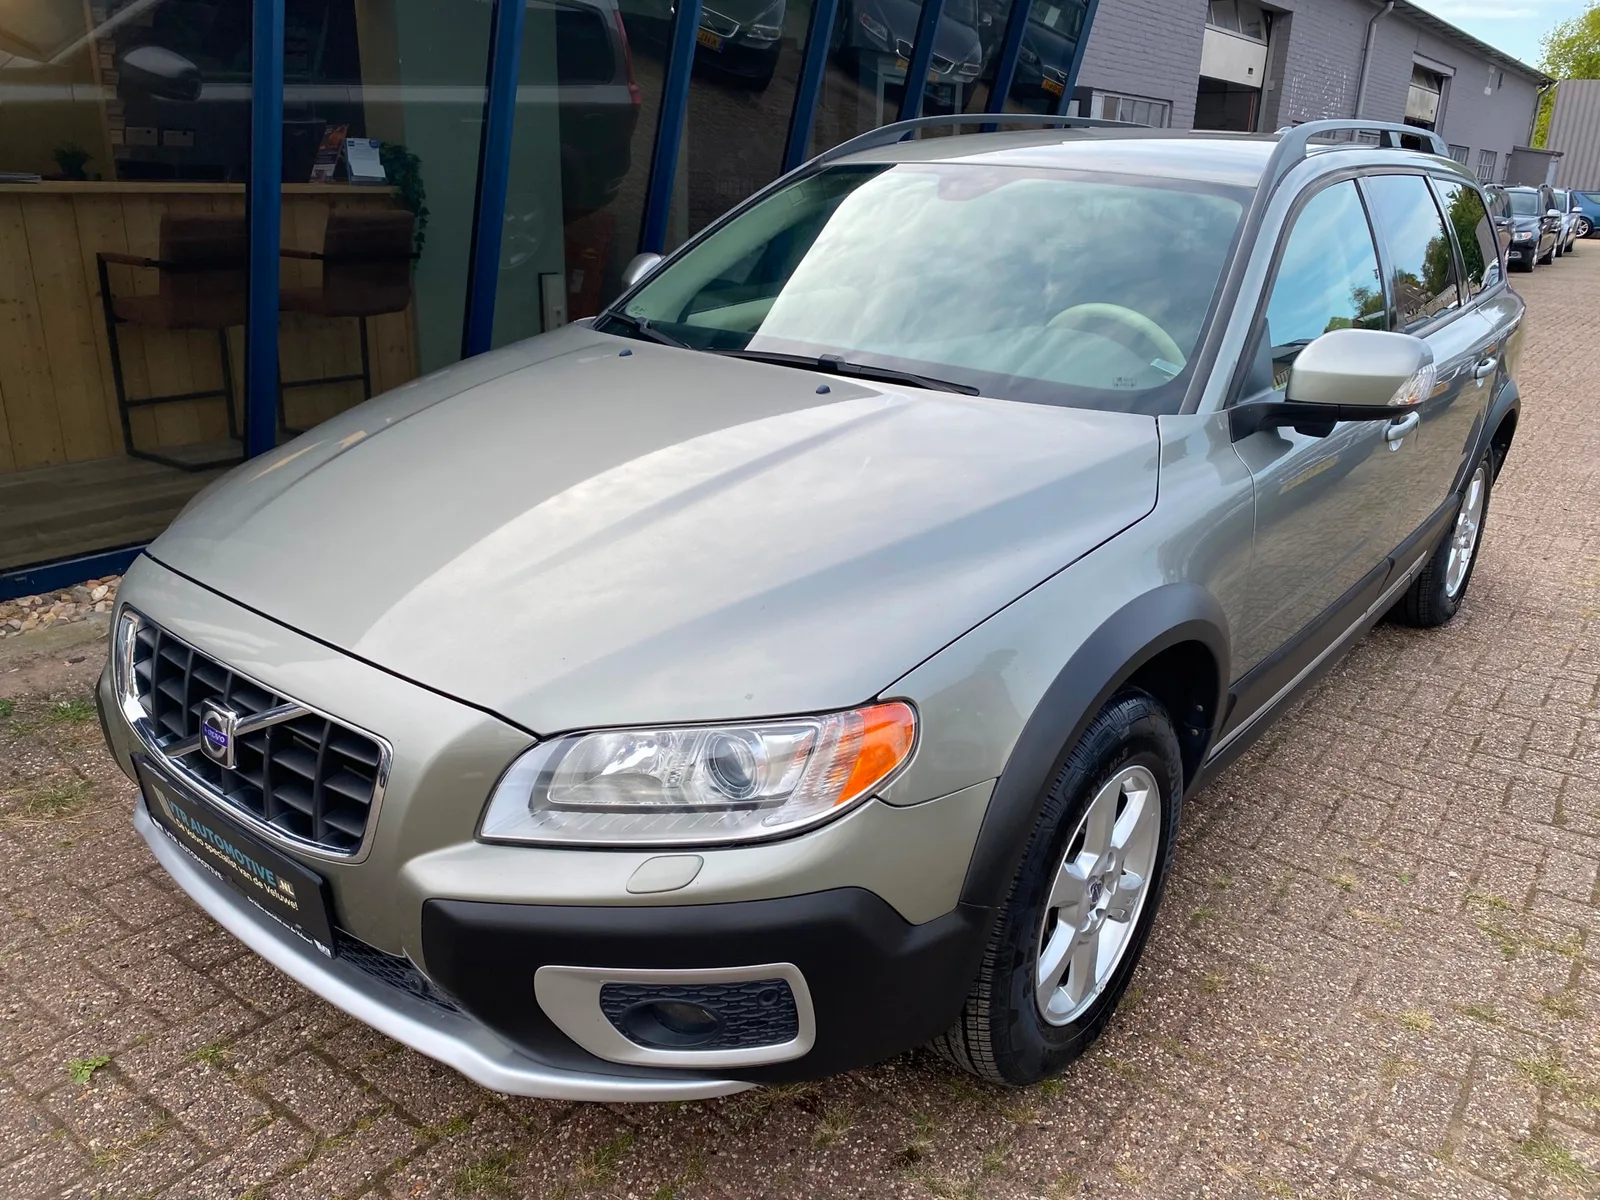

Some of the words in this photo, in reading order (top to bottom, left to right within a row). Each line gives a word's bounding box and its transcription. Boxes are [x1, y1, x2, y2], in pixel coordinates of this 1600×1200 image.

[204, 725, 226, 743] VOLVO
[167, 797, 190, 826] VTR
[191, 817, 277, 888] AUTOMOTIVE
[185, 826, 204, 846] Volvo
[204, 842, 239, 871] specialist
[238, 866, 253, 882] van
[253, 877, 264, 889] de
[264, 882, 299, 911] Veluwe!
